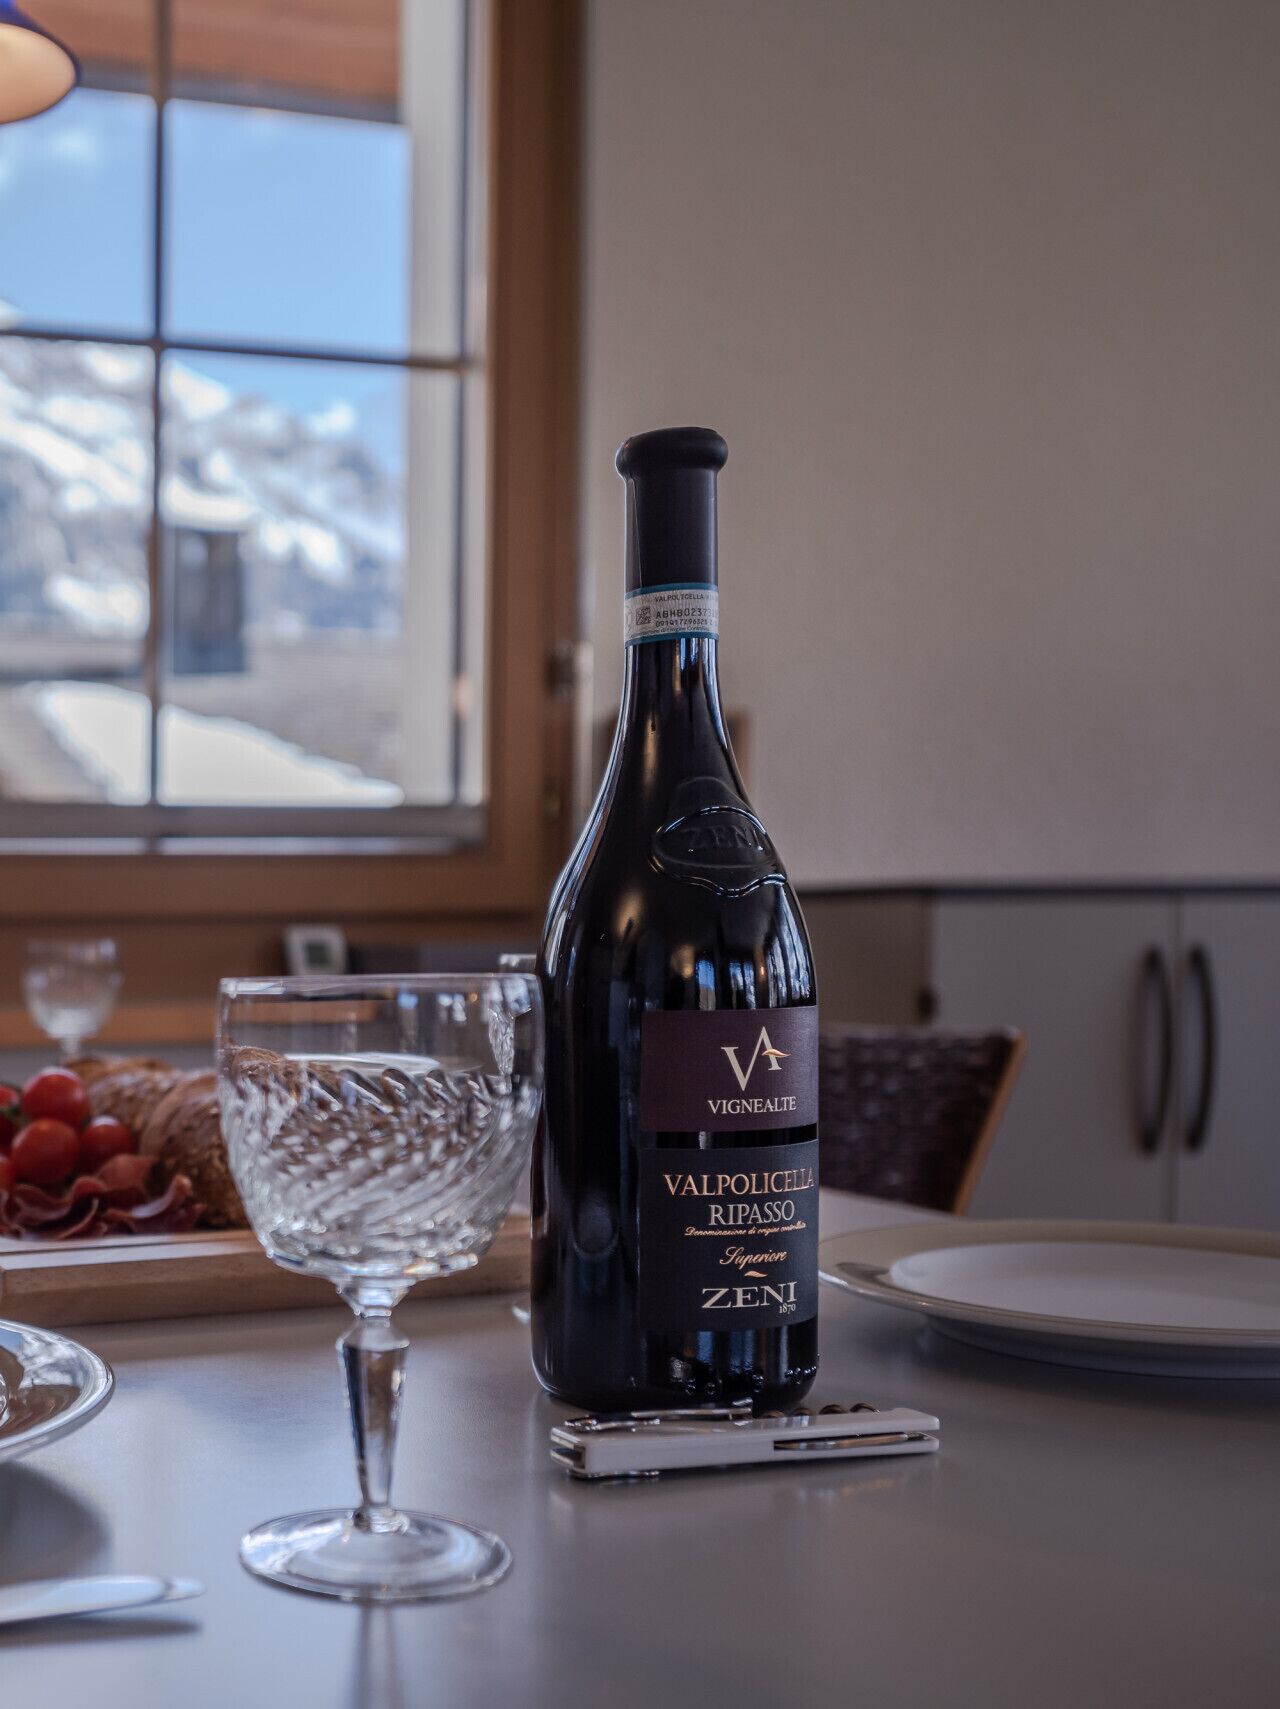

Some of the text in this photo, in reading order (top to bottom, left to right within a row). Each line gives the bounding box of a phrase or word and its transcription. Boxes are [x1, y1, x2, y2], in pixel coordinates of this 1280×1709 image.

[654, 593, 704, 602] VALPOLICELLA
[707, 1096, 797, 1114] VIGNEALTE
[663, 1167, 815, 1196] VALPOLICELLA
[708, 1200, 795, 1226] RIPASSO
[684, 1226, 747, 1237] Denominazione
[747, 1226, 757, 1235] di
[719, 1246, 788, 1269] Superiore
[701, 1281, 798, 1309] ZENI
[779, 1302, 797, 1315] 1870
